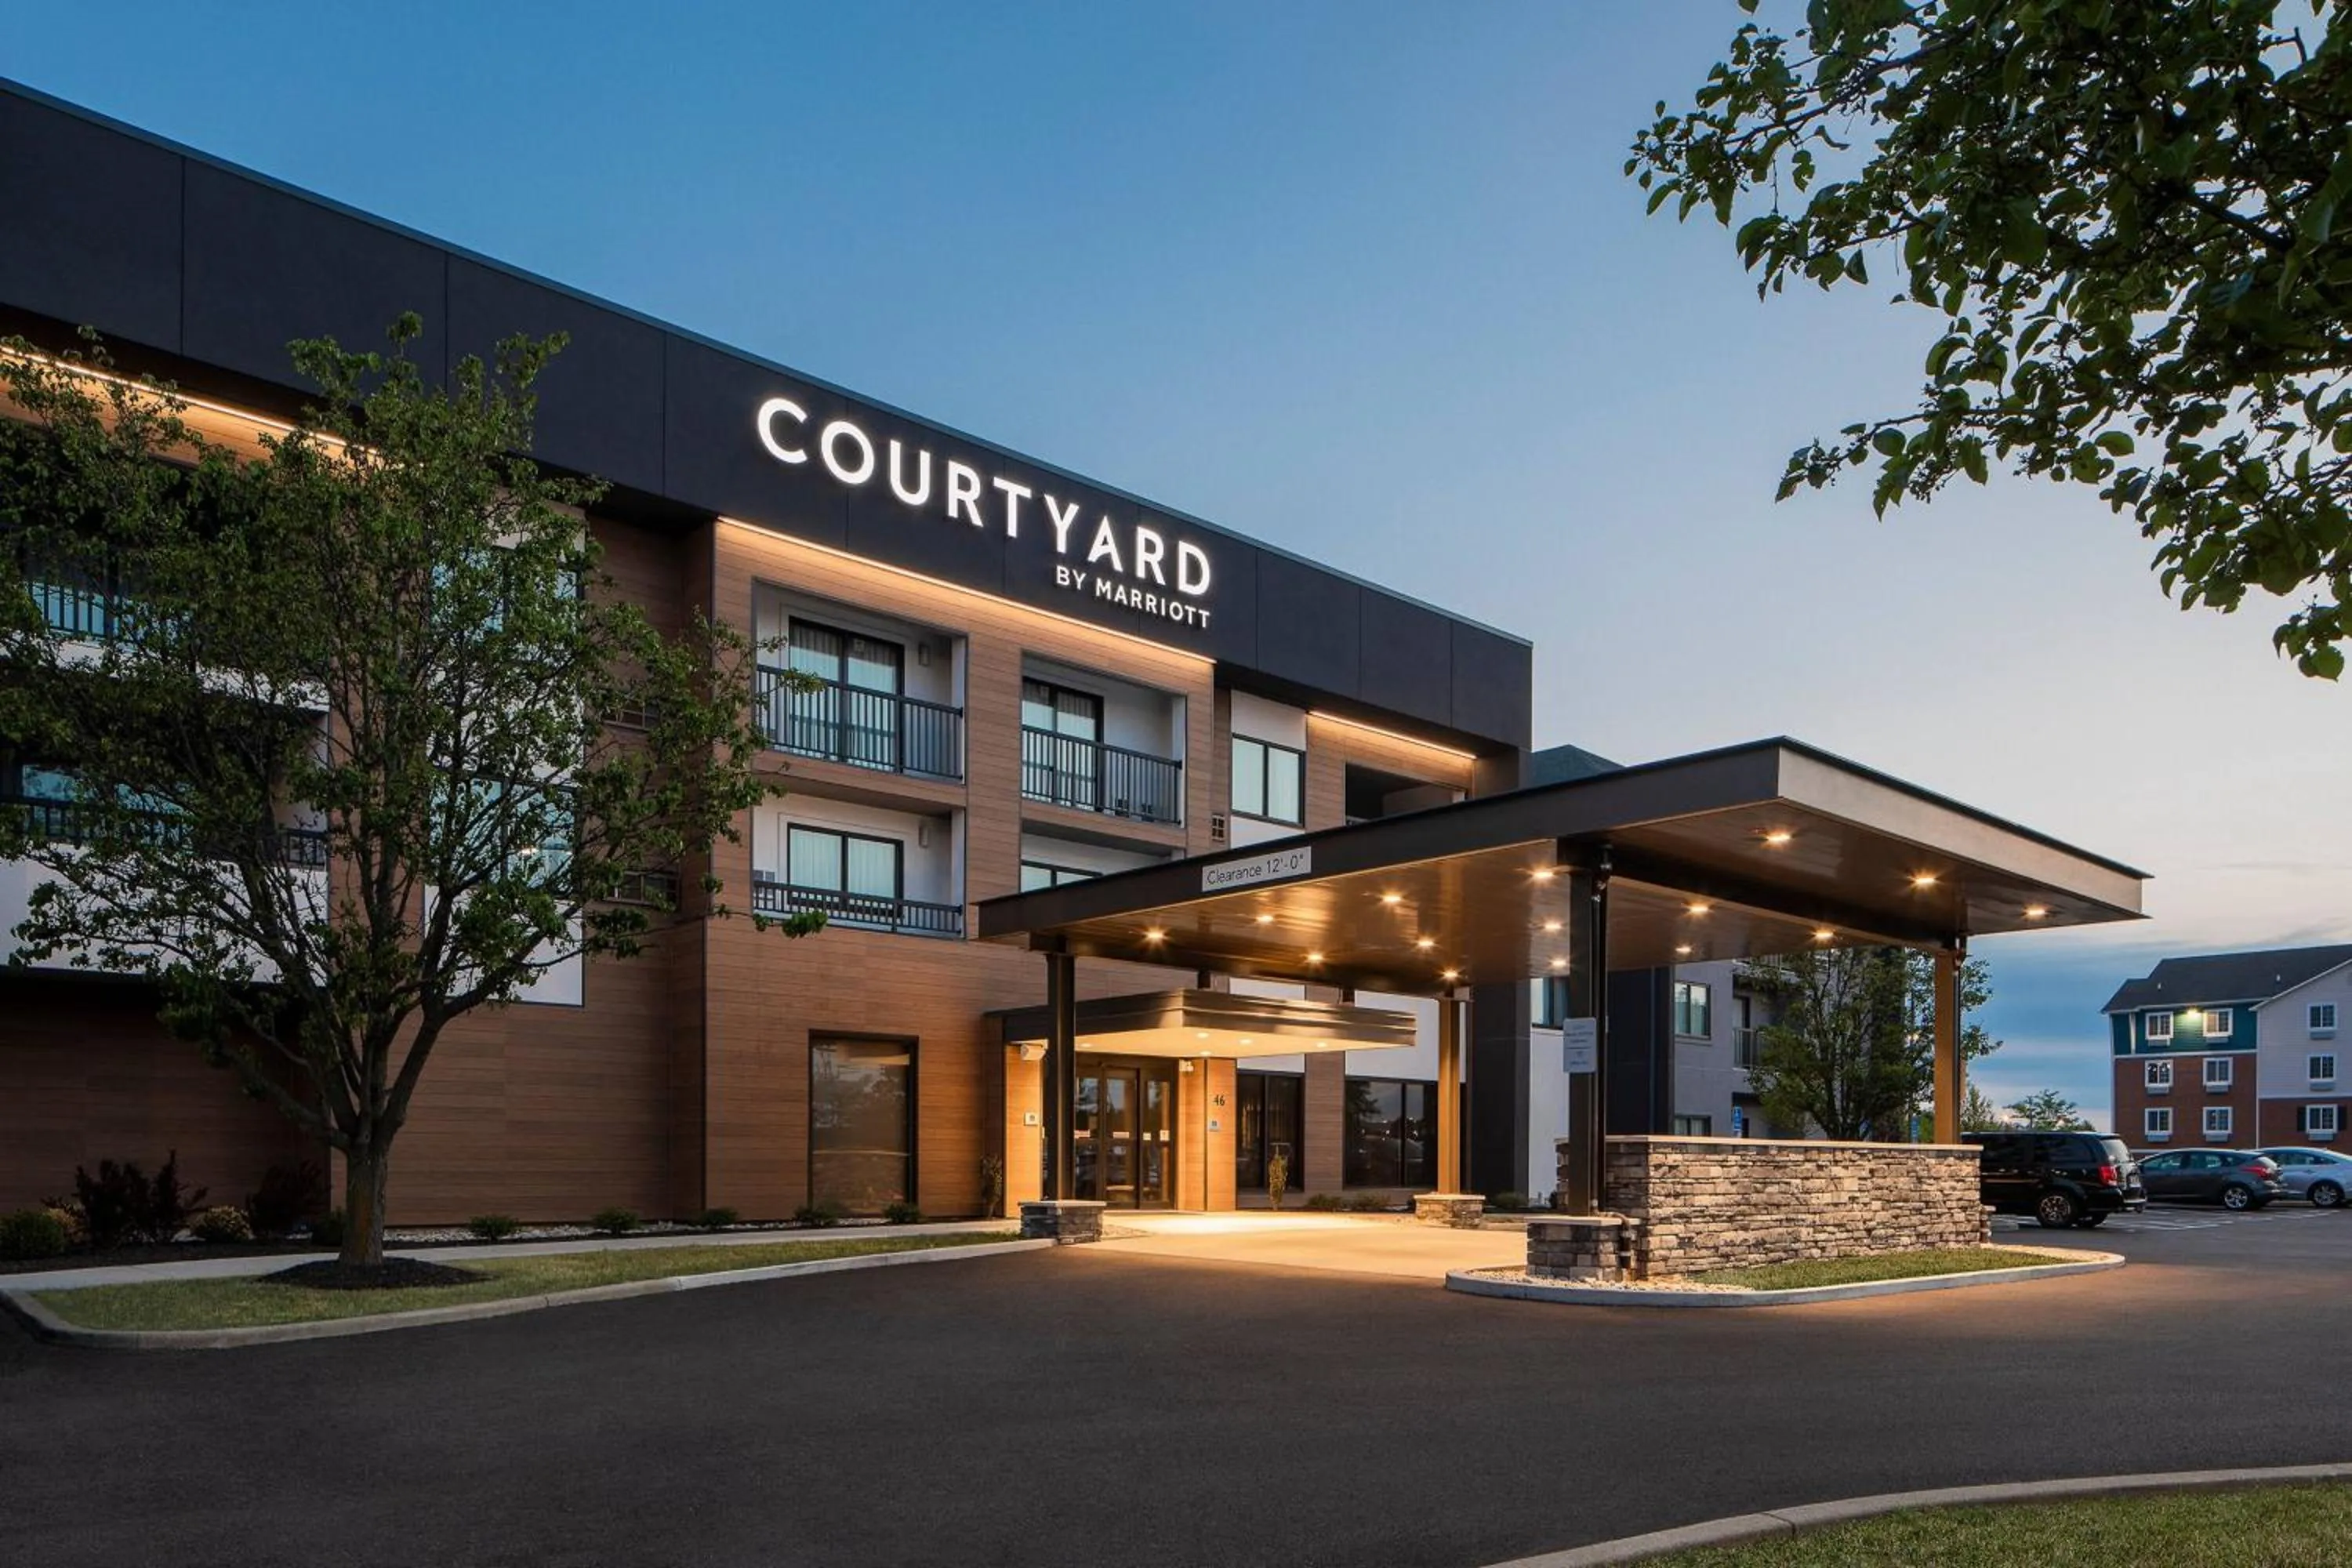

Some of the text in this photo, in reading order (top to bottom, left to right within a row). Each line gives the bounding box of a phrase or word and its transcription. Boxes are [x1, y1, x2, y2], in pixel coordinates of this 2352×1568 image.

[757, 397, 1211, 596] COURTYARD
[1056, 564, 1210, 628] BY MARRIOTT
[1207, 865, 1261, 885] Clearance
[1212, 1094, 1225, 1106] 46
